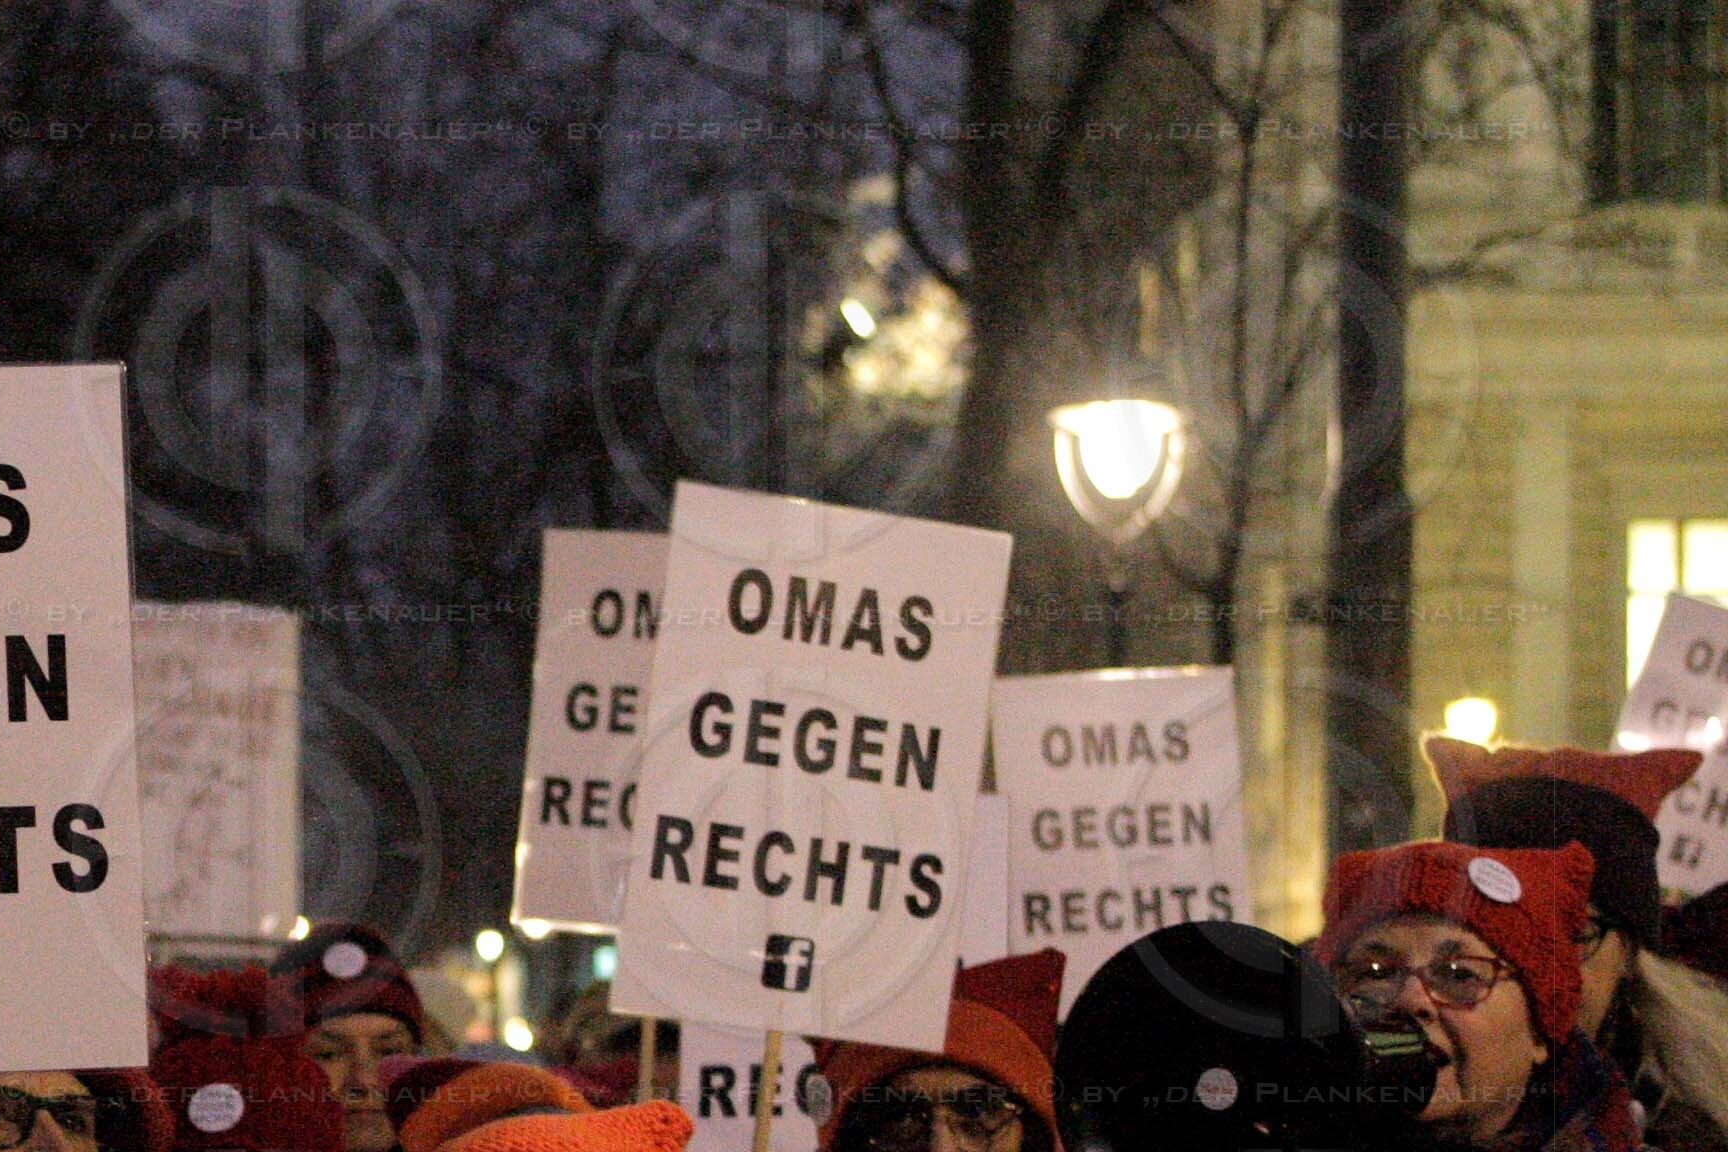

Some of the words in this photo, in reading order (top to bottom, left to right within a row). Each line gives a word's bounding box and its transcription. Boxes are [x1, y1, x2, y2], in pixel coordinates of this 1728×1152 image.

[728, 568, 933, 662] OMAS
[689, 691, 941, 791] GEGEN
[1041, 720, 1191, 769] OMAS
[1031, 803, 1214, 853] GEGEN
[649, 815, 943, 919] RECHTS
[1023, 884, 1234, 934] RECHTS
